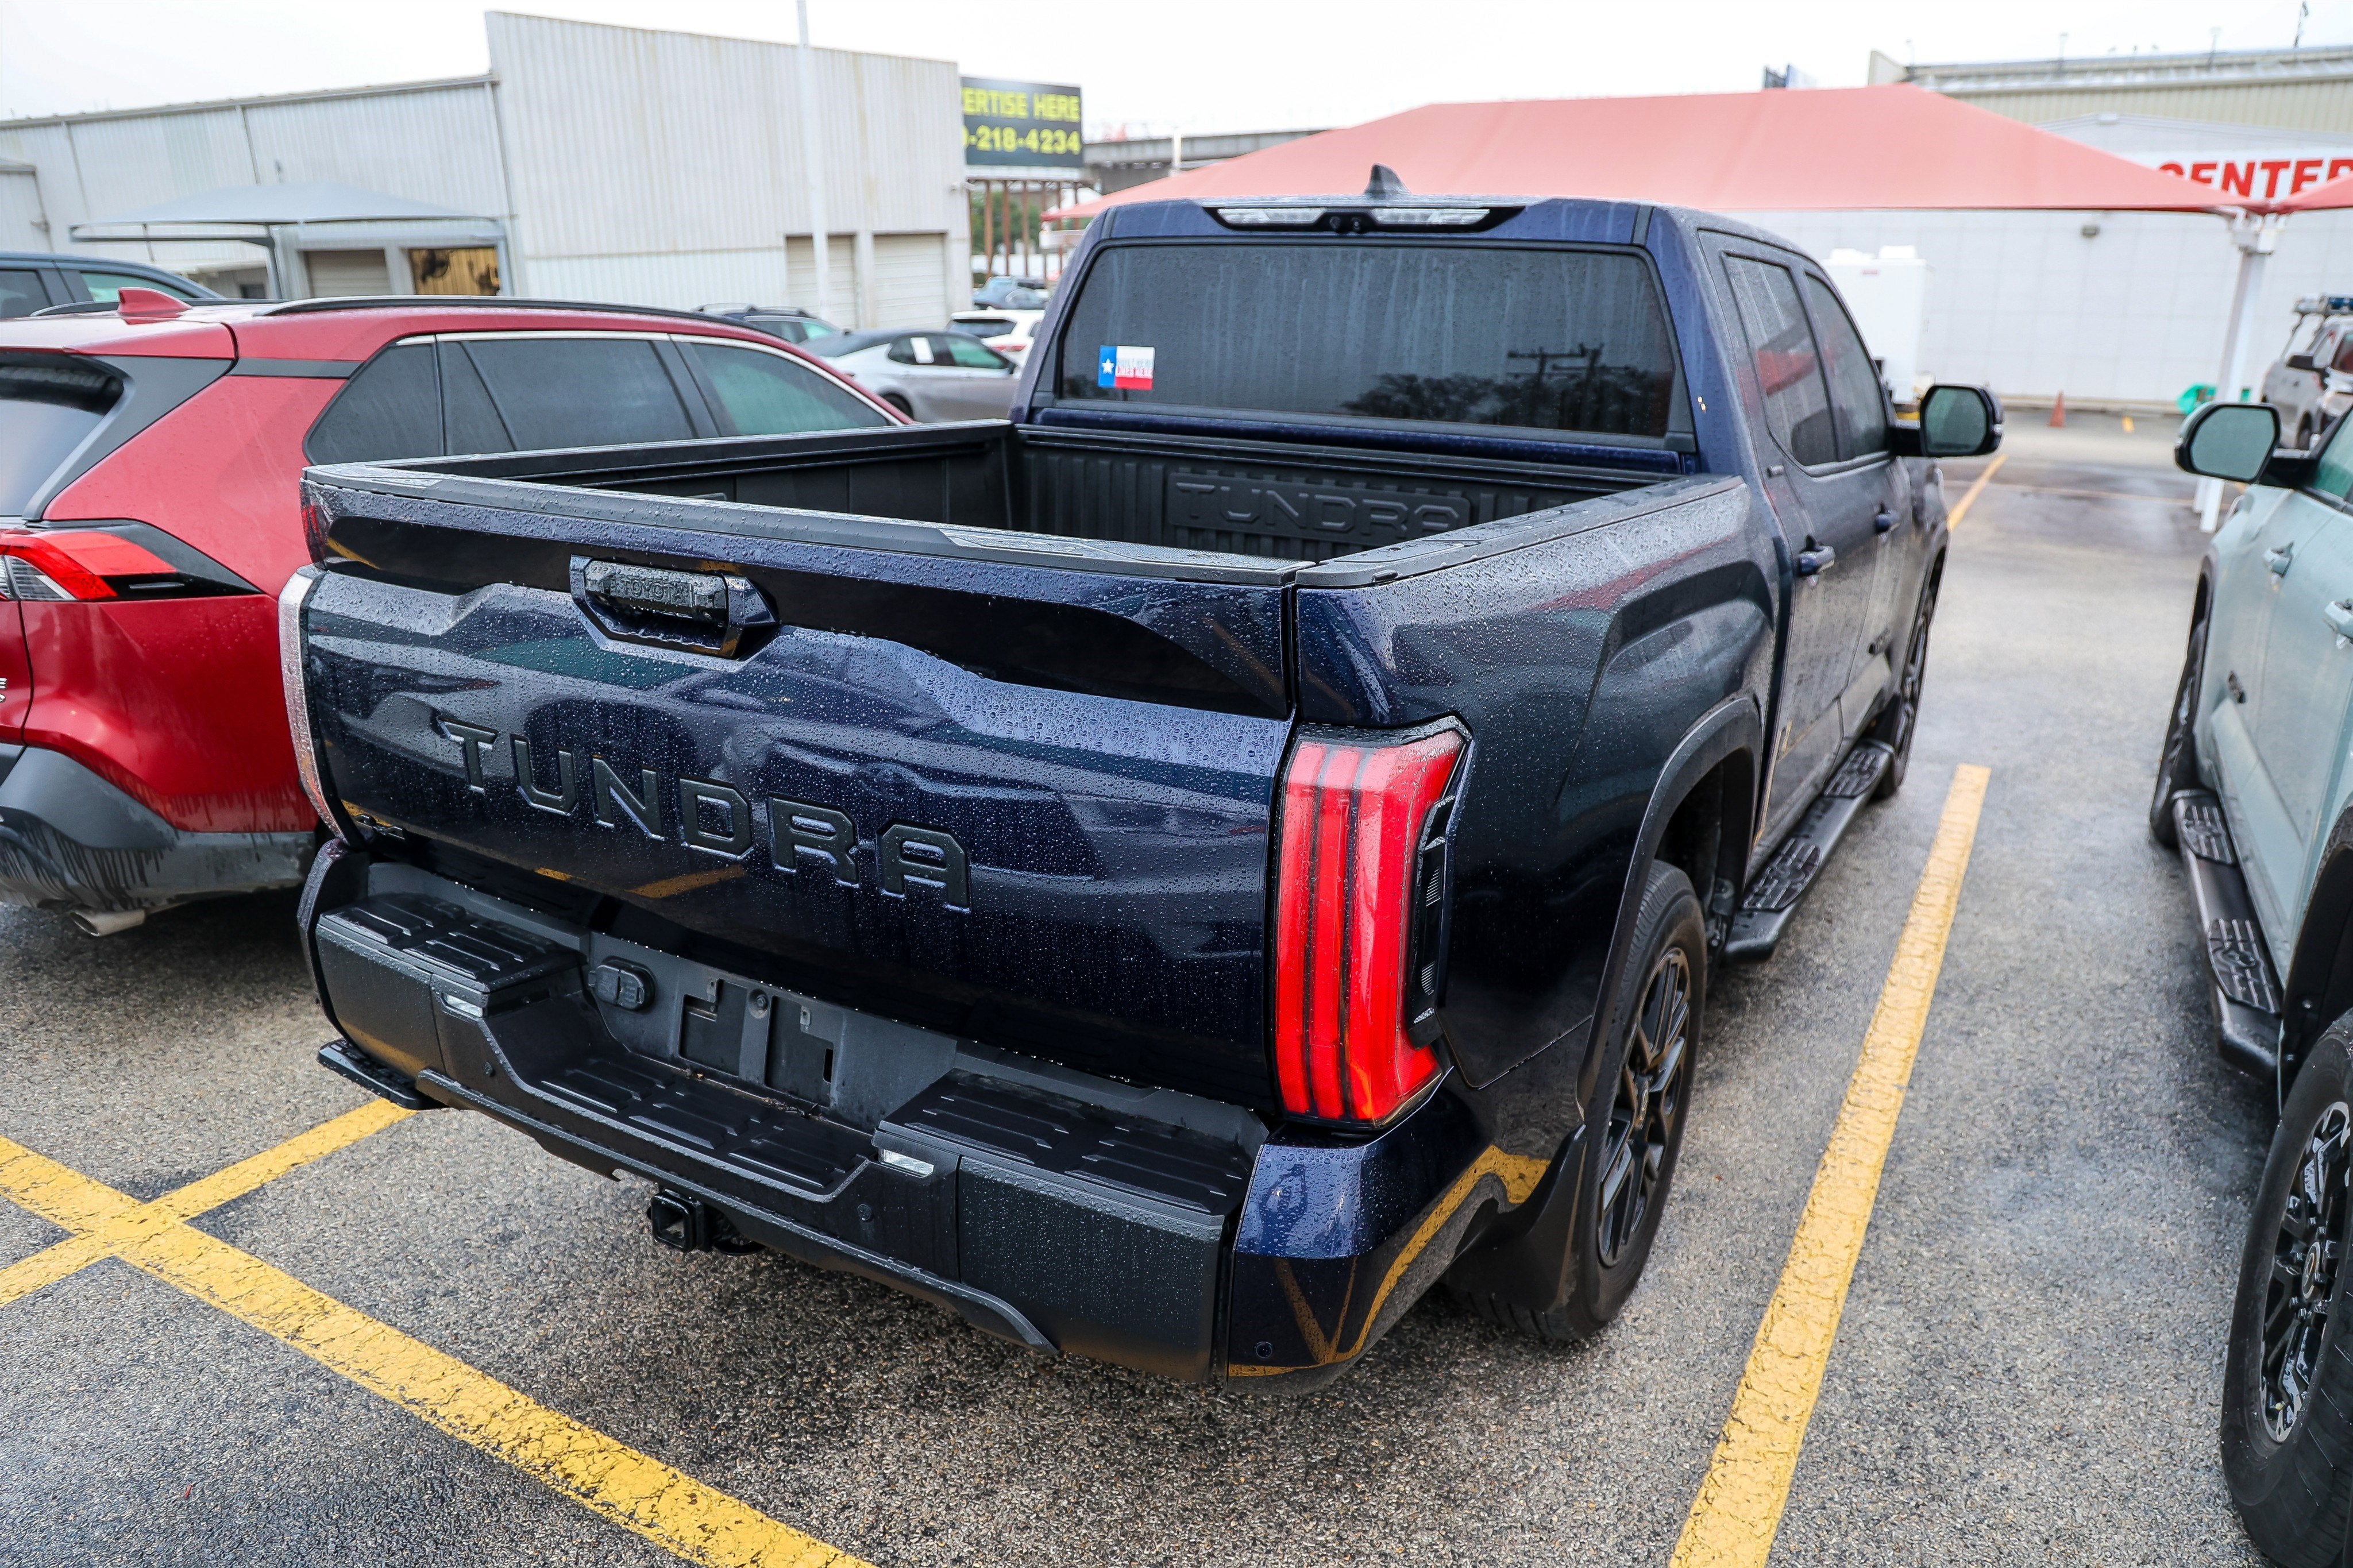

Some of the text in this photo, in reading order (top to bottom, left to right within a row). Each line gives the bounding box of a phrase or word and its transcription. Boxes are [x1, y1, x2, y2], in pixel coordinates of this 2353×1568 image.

[962, 87, 1081, 123] ERTISE HERE
[1175, 481, 1460, 538] TUNDRA
[620, 577, 687, 603] TOYOTA
[437, 716, 972, 914] TUNDRA
